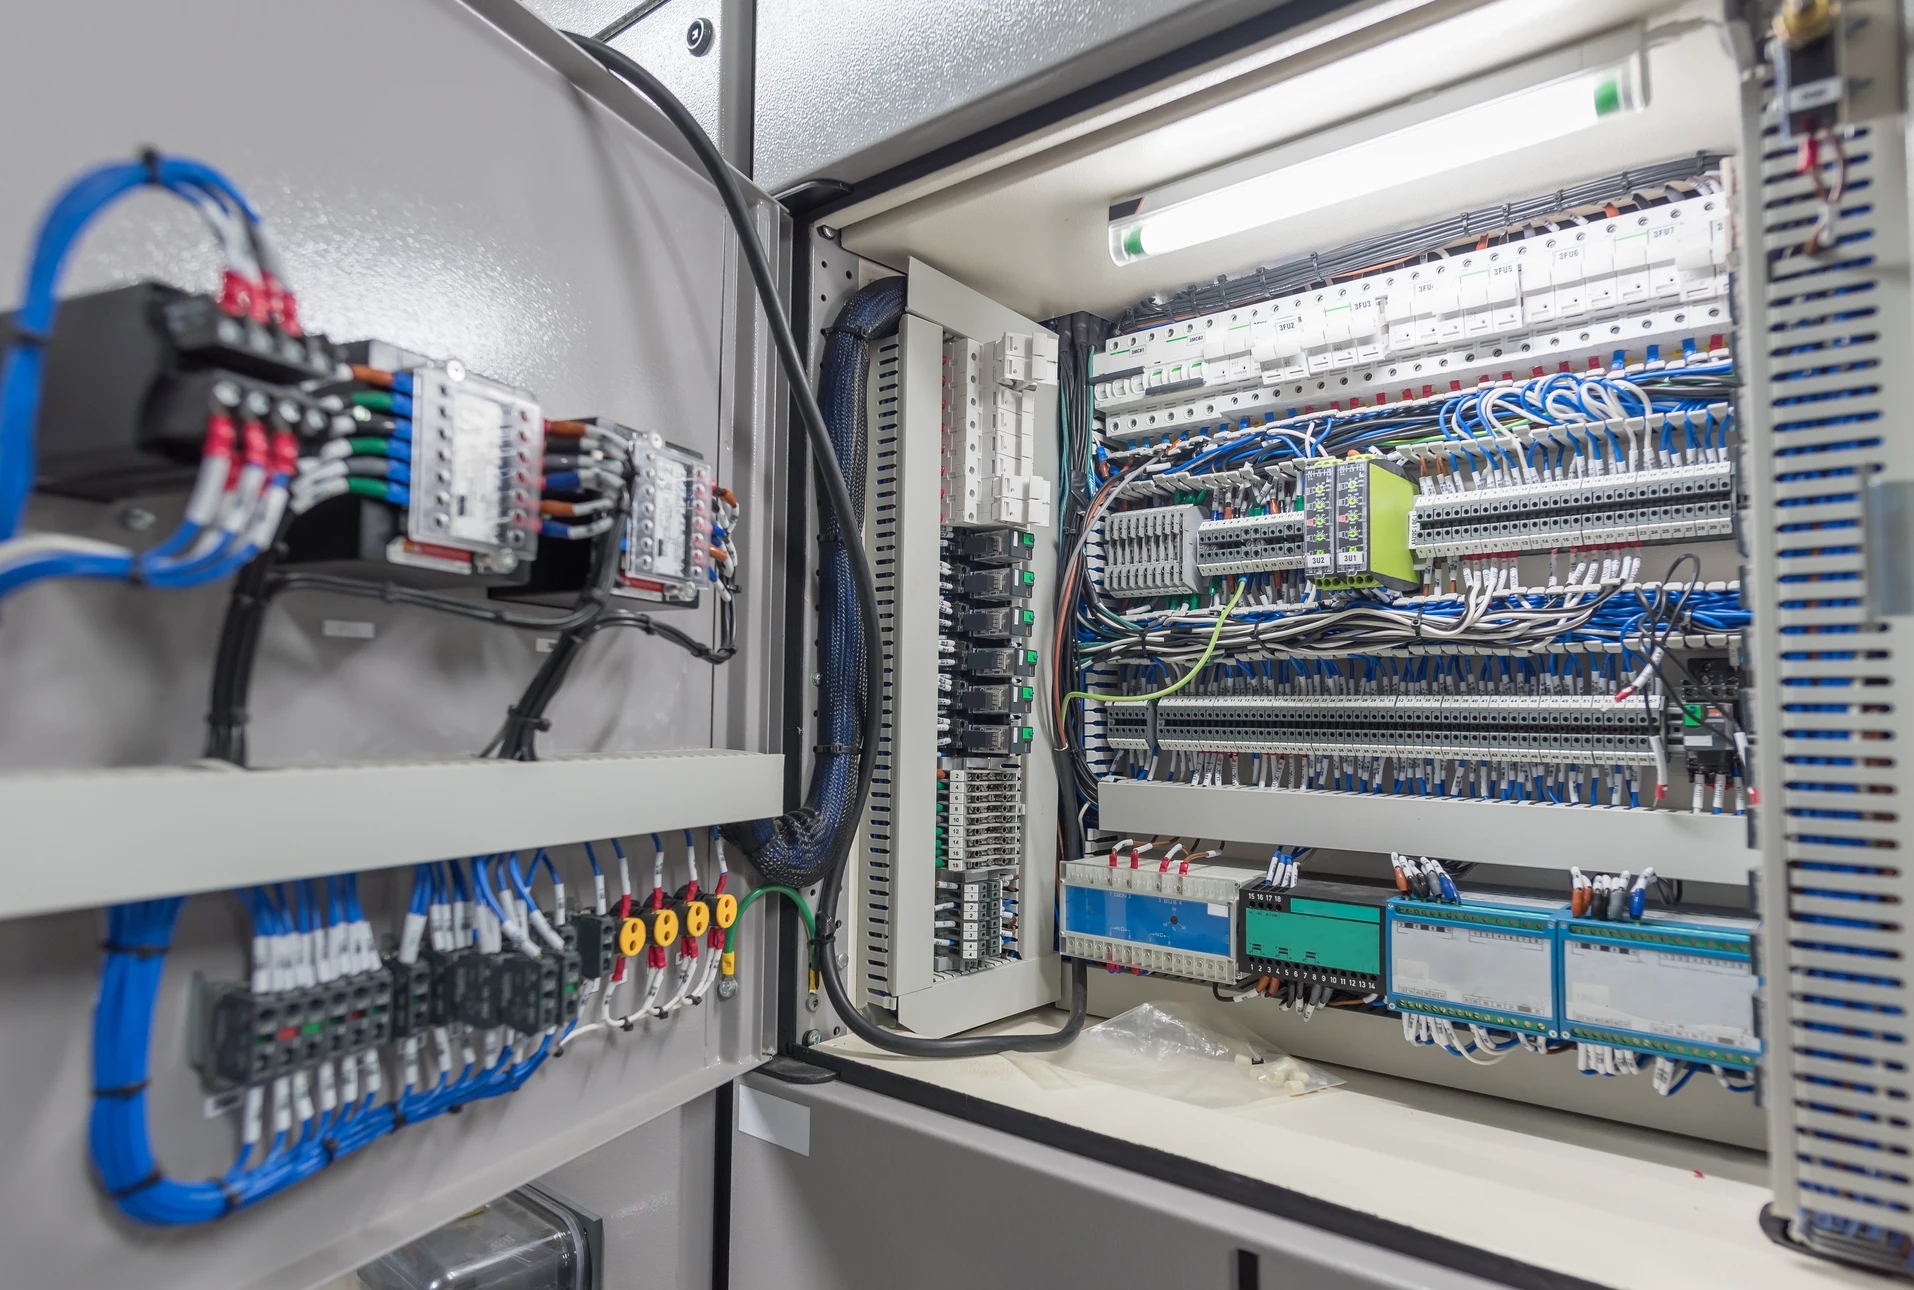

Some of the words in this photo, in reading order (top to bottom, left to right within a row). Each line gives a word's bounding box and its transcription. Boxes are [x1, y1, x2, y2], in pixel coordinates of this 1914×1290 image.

[1418, 283, 1434, 293] 3FU
[1354, 300, 1371, 310] 3FU3
[1279, 322, 1295, 331] 3FU2
